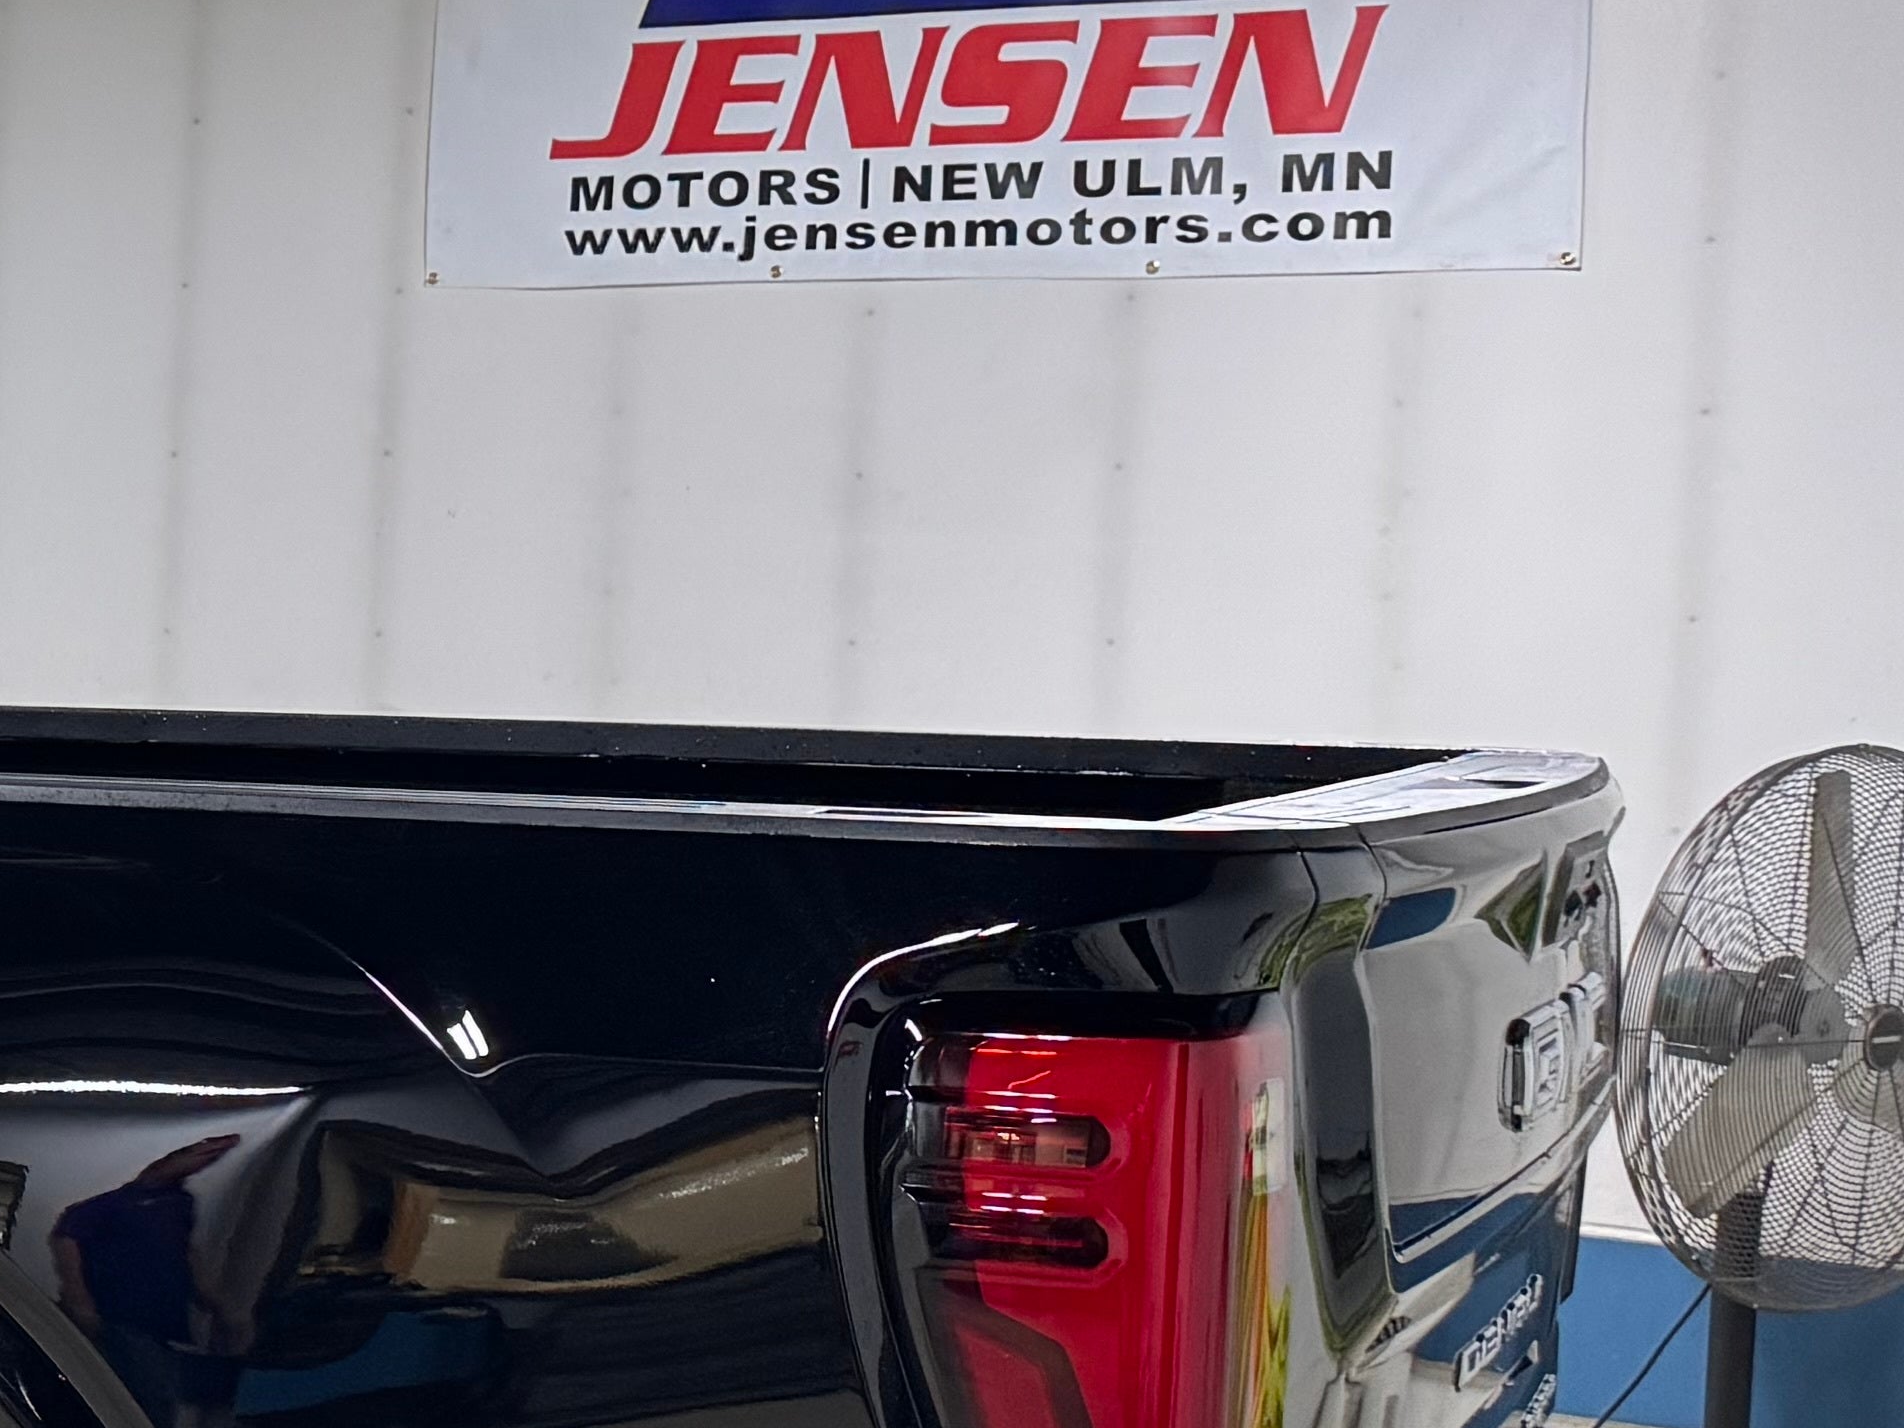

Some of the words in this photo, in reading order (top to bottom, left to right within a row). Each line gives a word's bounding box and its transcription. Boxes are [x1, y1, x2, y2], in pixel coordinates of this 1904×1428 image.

[550, 5, 1387, 160] JENSEN
[570, 167, 840, 212] MOTORS
[891, 161, 1044, 203] NEW
[1072, 157, 1247, 205] ULM,
[1281, 150, 1392, 193] MN
[564, 208, 1392, 262] www.jensenmotors.com
